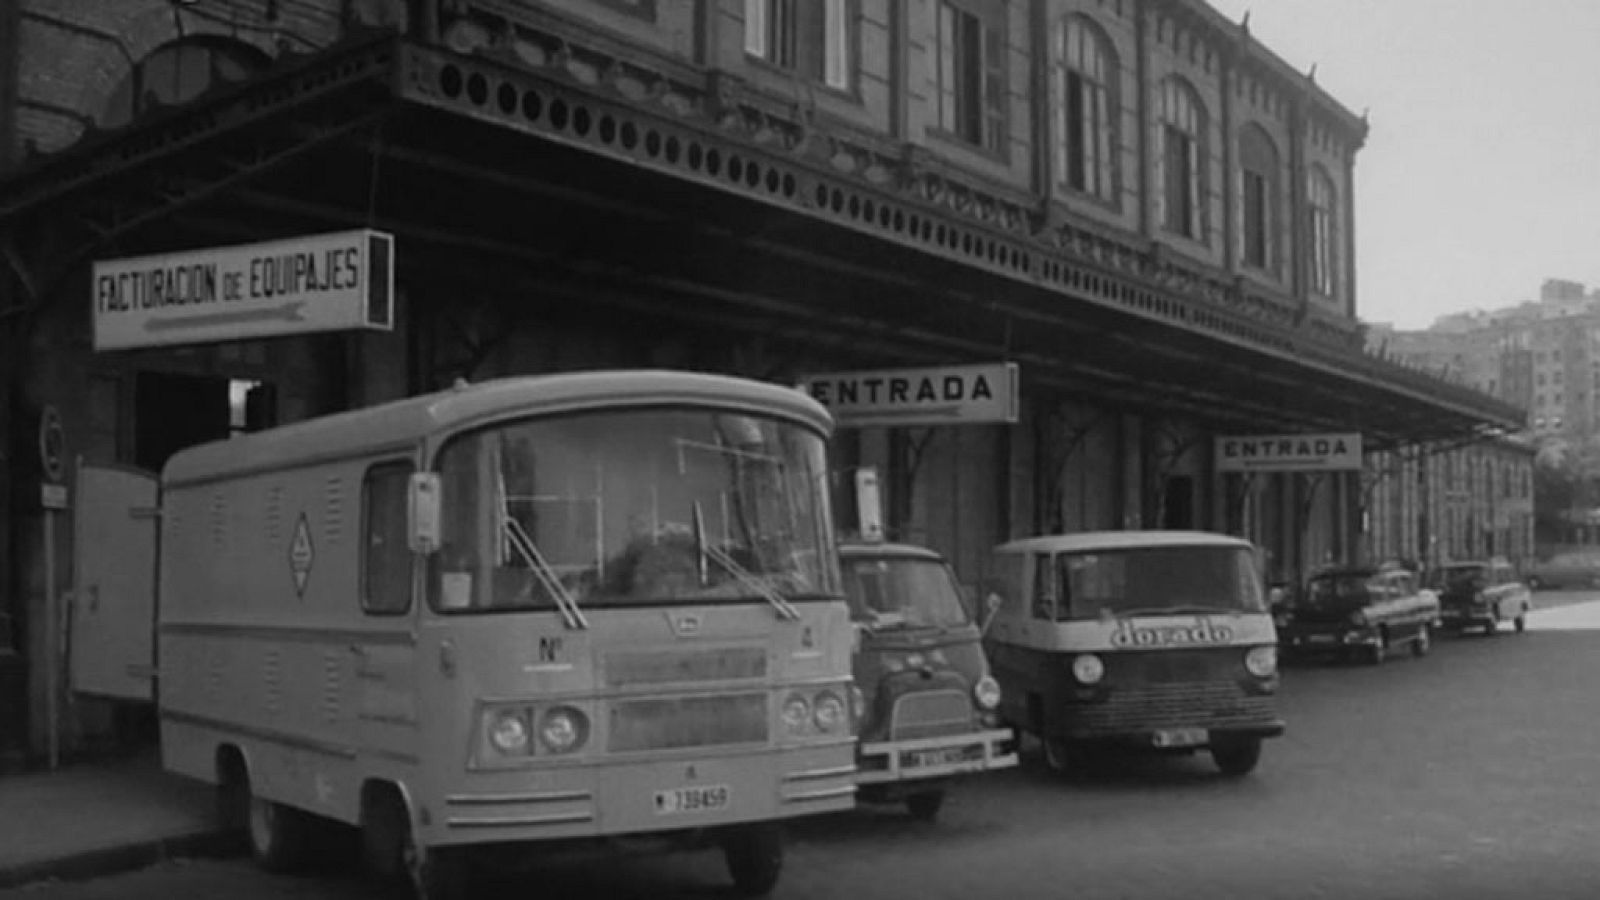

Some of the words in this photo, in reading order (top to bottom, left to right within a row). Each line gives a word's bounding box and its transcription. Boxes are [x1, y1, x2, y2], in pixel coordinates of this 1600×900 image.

[98, 262, 217, 313] FACTURACION
[222, 270, 244, 301] DE
[250, 246, 359, 299] EQUIPAJES
[811, 374, 993, 406] ENTRADA
[1223, 437, 1348, 458] ENTRADA
[1110, 617, 1235, 649] dorado
